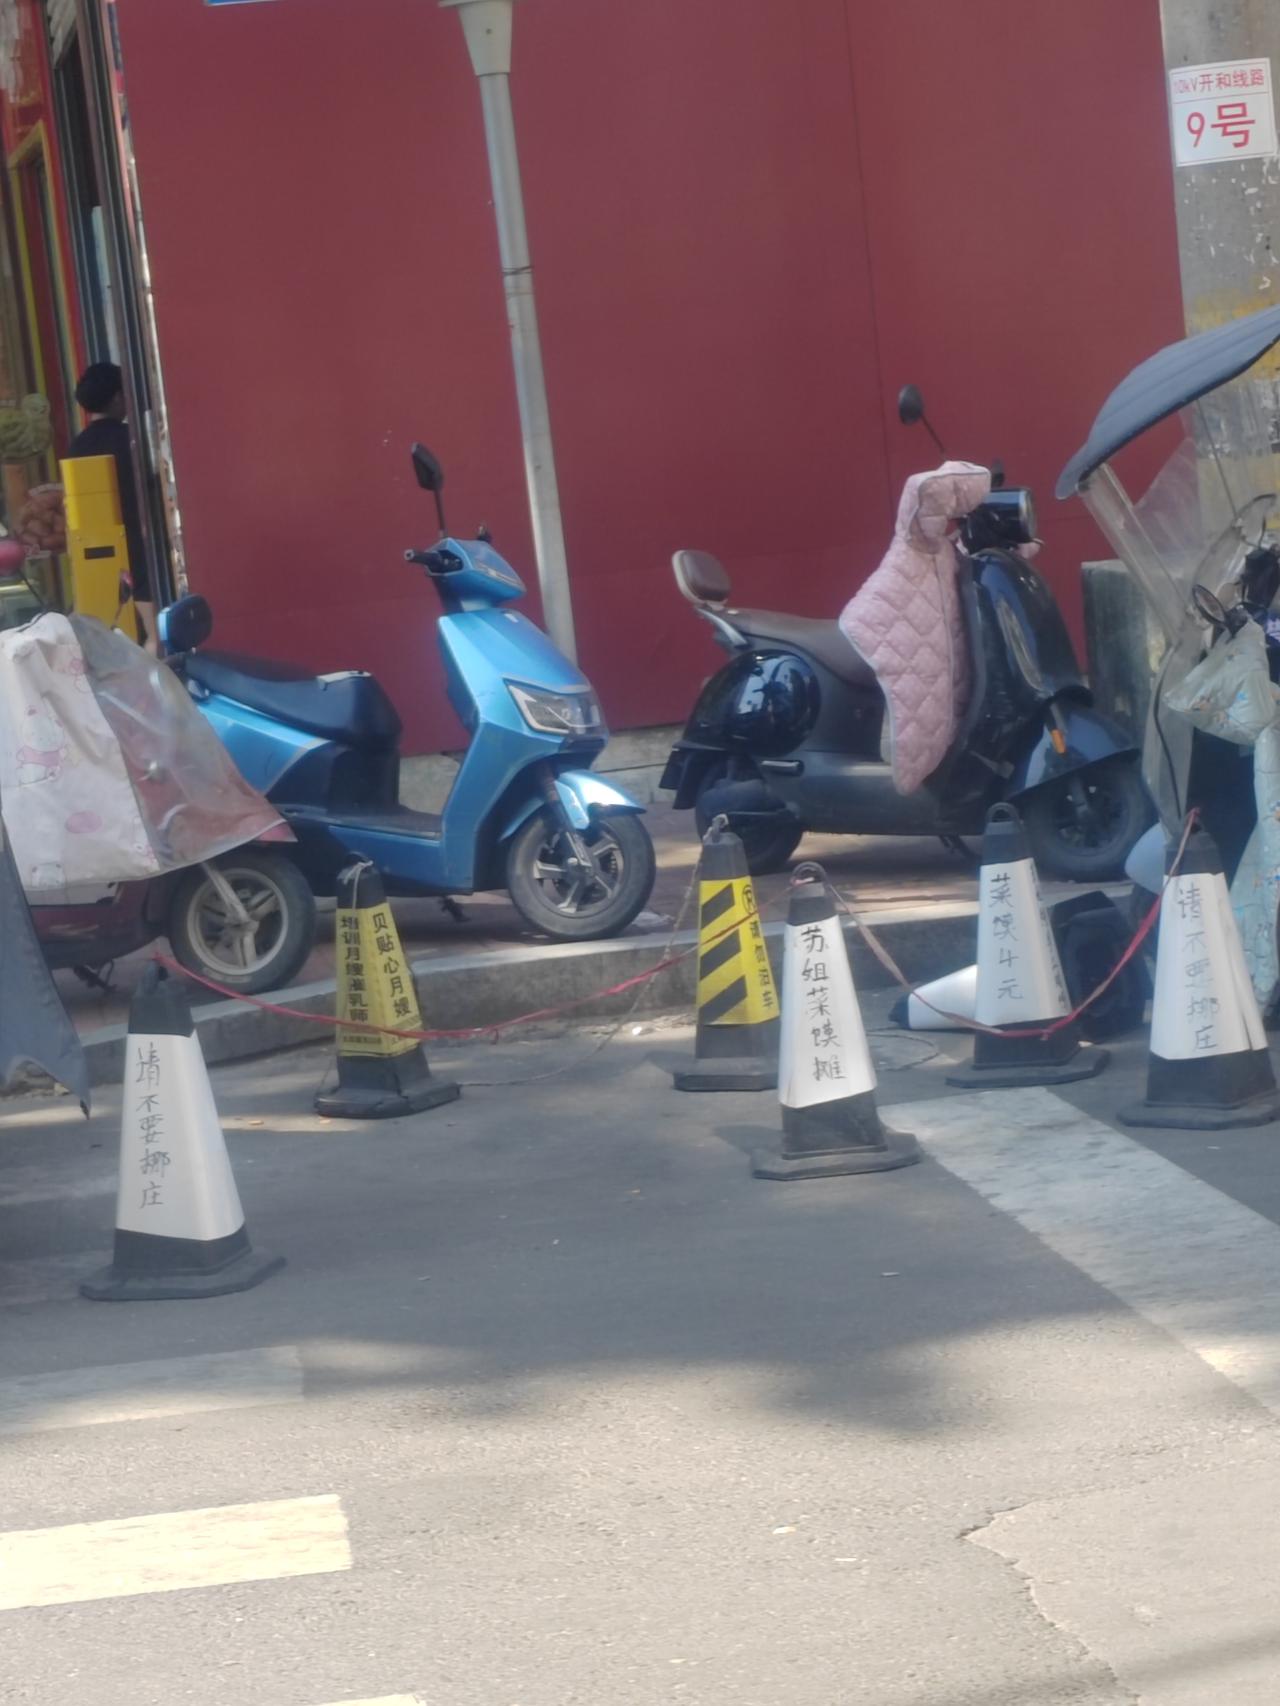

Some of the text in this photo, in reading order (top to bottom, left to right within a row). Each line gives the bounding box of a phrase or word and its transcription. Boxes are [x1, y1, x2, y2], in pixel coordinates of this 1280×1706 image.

[1186, 102, 1256, 149] 9号
[800, 925, 848, 1082] 苏姐菜馍摊
